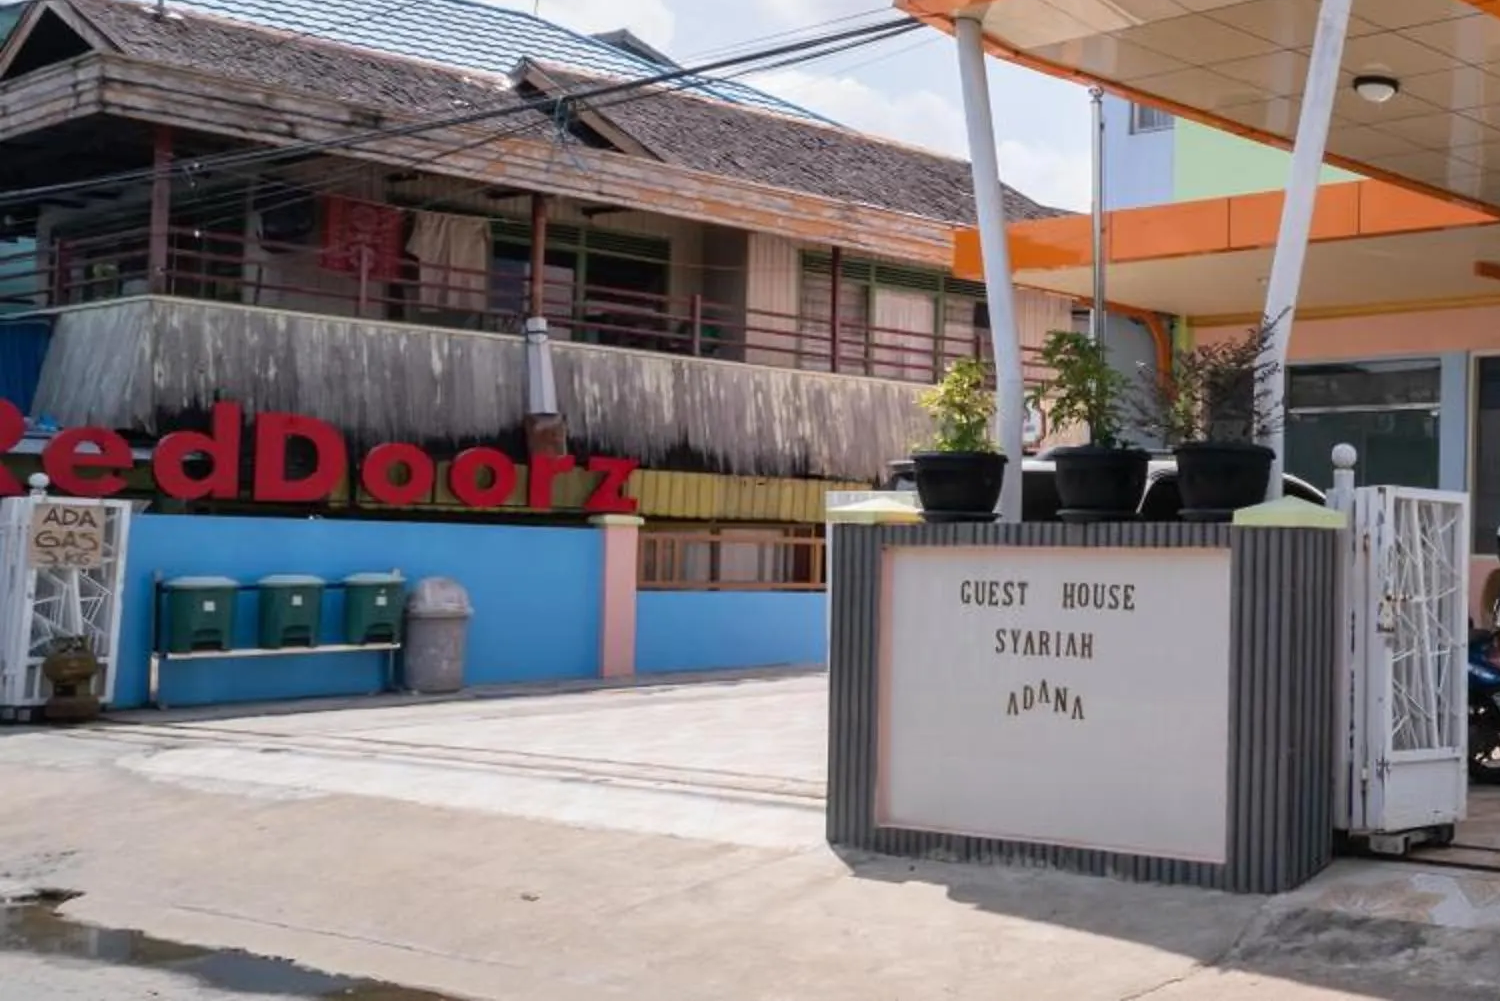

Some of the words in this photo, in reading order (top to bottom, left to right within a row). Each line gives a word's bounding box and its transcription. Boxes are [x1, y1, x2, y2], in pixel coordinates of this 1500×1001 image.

[42, 507, 97, 529] ADA
[35, 530, 99, 552] GAS
[960, 580, 1029, 607] GUEST
[1062, 582, 1136, 611] HOUSE
[995, 628, 1094, 660] SYARIAH
[1006, 678, 1085, 720] ADANA
